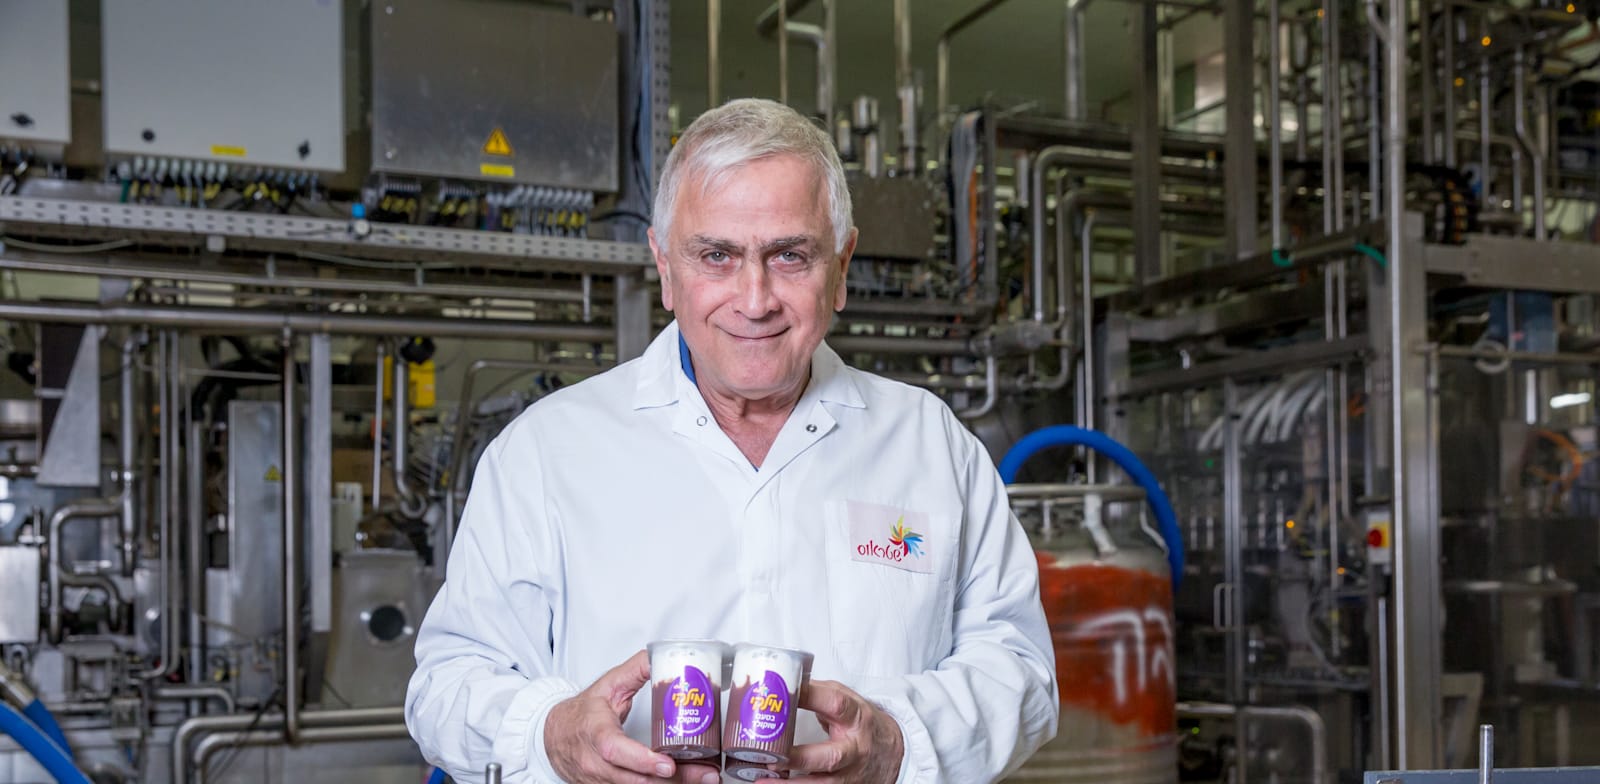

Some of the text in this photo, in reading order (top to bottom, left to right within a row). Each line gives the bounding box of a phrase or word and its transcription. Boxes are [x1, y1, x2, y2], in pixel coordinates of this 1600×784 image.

[857, 539, 903, 562] שטראוס
[672, 688, 705, 706] מילקי
[750, 694, 783, 712] מילקי
[755, 712, 776, 722] בטעם
